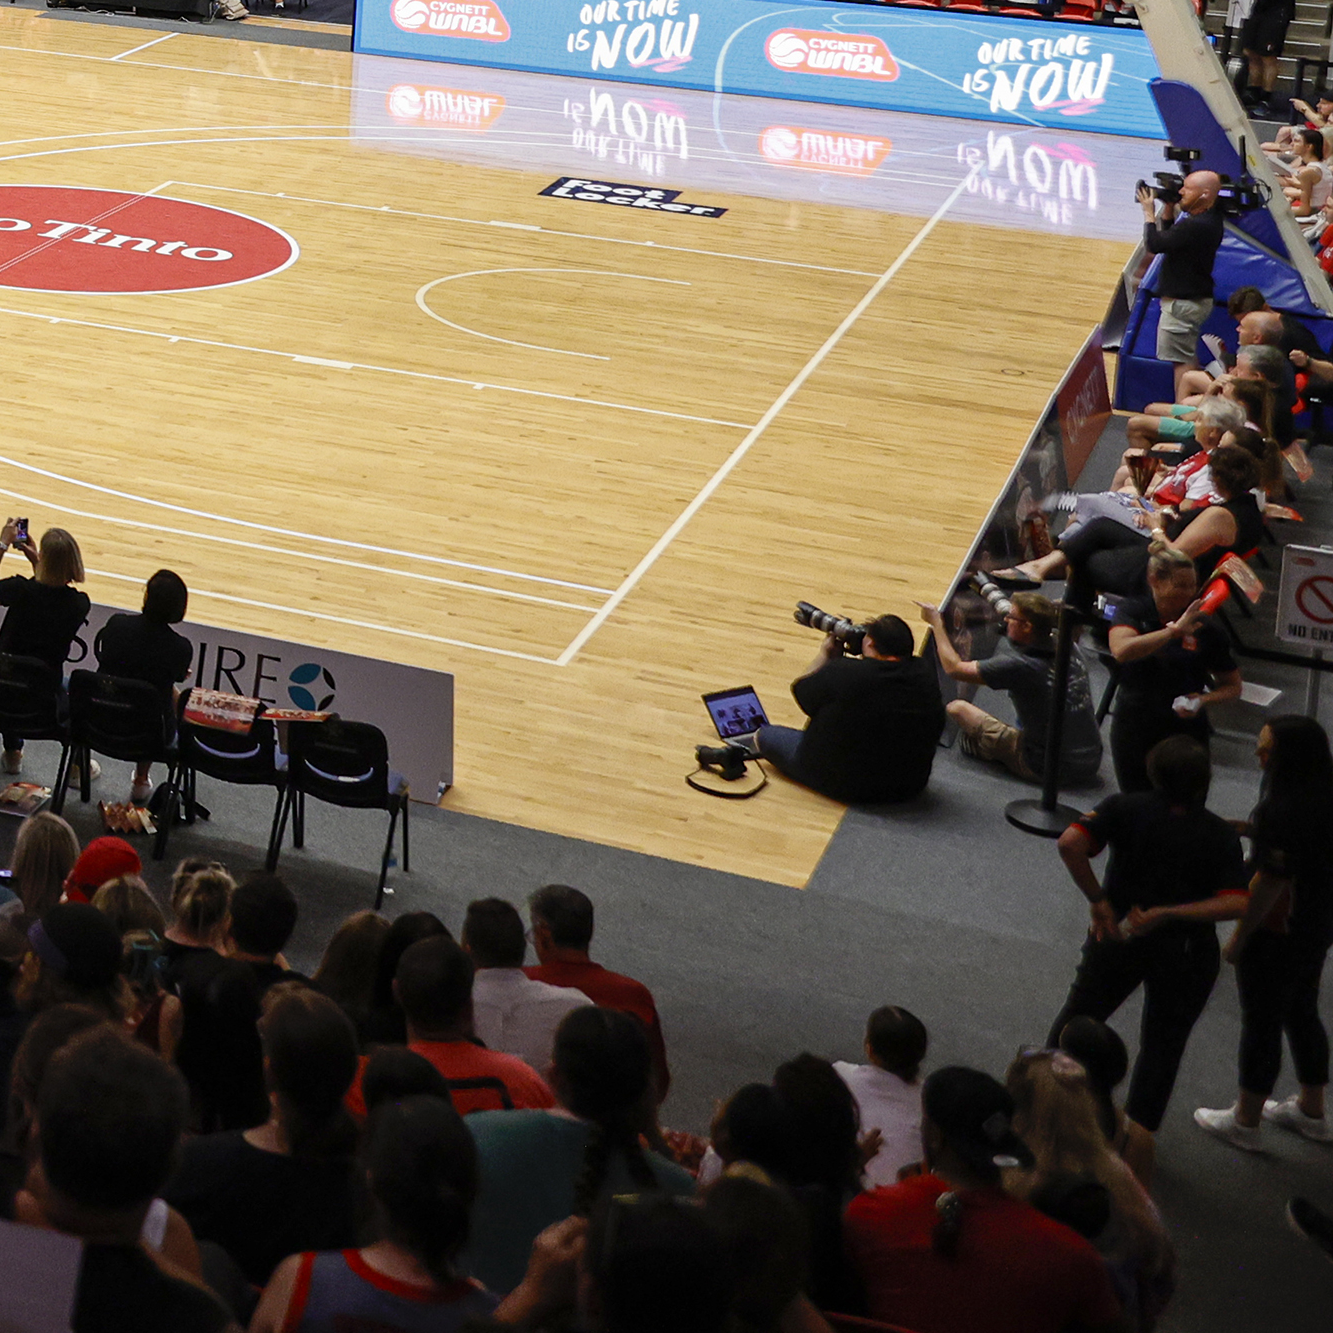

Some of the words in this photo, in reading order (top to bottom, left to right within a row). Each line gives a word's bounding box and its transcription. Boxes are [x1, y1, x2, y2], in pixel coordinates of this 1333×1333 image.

[429, 1, 491, 16] CYGNETT
[579, 0, 621, 25] OUR
[428, 12, 503, 37] WNBL
[566, 28, 591, 54] IS
[591, 13, 700, 72] NOW
[808, 37, 876, 54] CYGNETT
[977, 38, 1026, 65] OUR
[1030, 34, 1092, 62] TIME
[807, 49, 892, 76] WNBL
[962, 68, 991, 94] IS
[990, 53, 1114, 113] NOW
[559, 178, 666, 200] Foot
[35, 218, 235, 264] Tinto
[1287, 624, 1307, 637] NO
[1310, 625, 1333, 640] ENT
